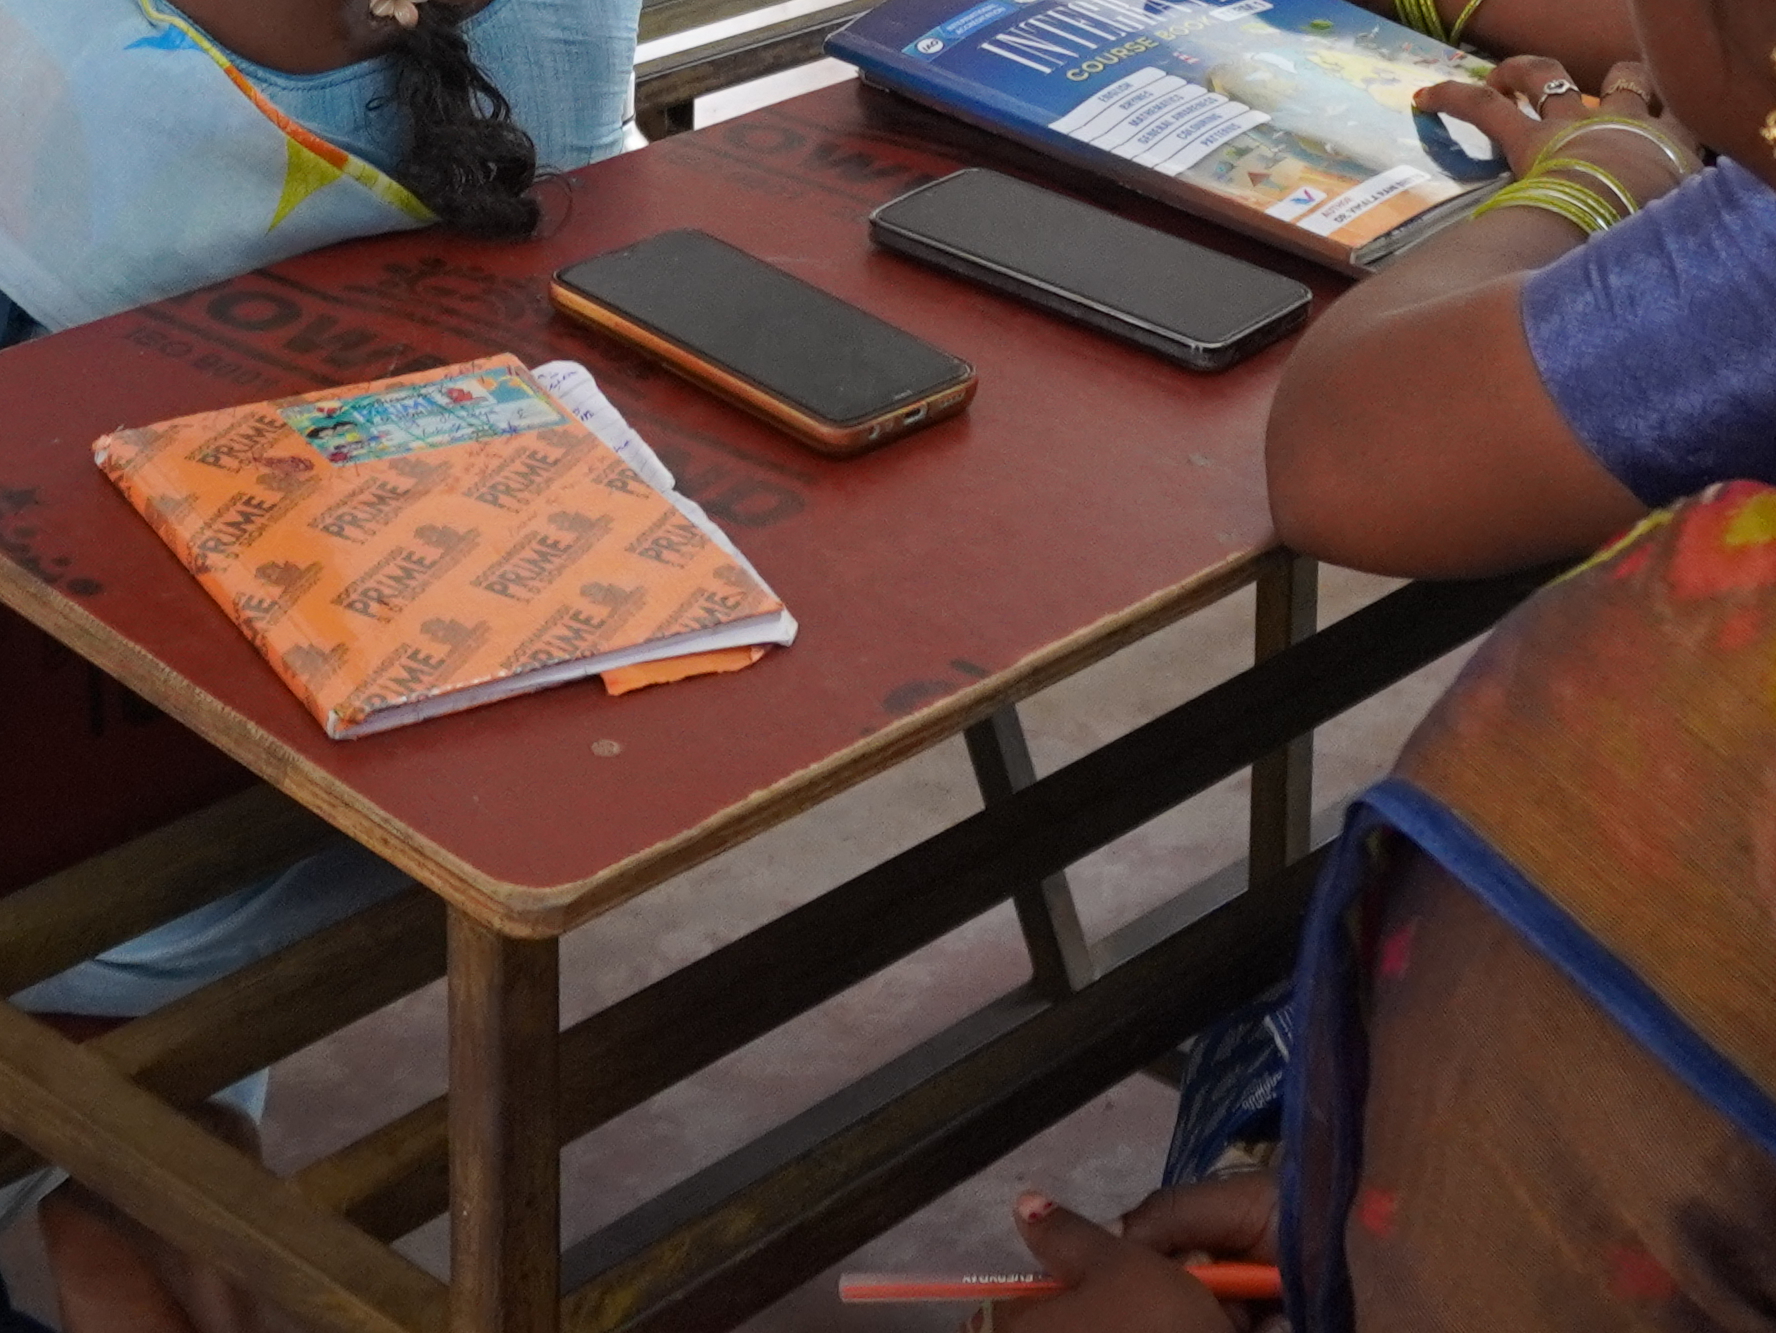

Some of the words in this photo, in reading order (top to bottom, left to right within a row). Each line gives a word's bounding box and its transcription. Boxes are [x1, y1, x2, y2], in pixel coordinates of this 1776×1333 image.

[1065, 34, 1160, 83] COURSE
[1155, 12, 1214, 44] BOOK
[1097, 80, 1135, 104] ENGLISH
[1118, 89, 1155, 111] RHYMES
[1127, 93, 1185, 128] MATHEMATICS
[1136, 117, 1174, 146] GENERAL
[1172, 95, 1220, 122] AWARENESS
[1175, 112, 1223, 141] COLOURING
[1199, 121, 1243, 148] PATTERNS
[1322, 195, 1354, 218] AUTHOR
[475, 449, 562, 508] PRIME
[320, 480, 413, 542] PRIME
[344, 549, 441, 619] PRIME
[483, 534, 574, 600] PRIME
